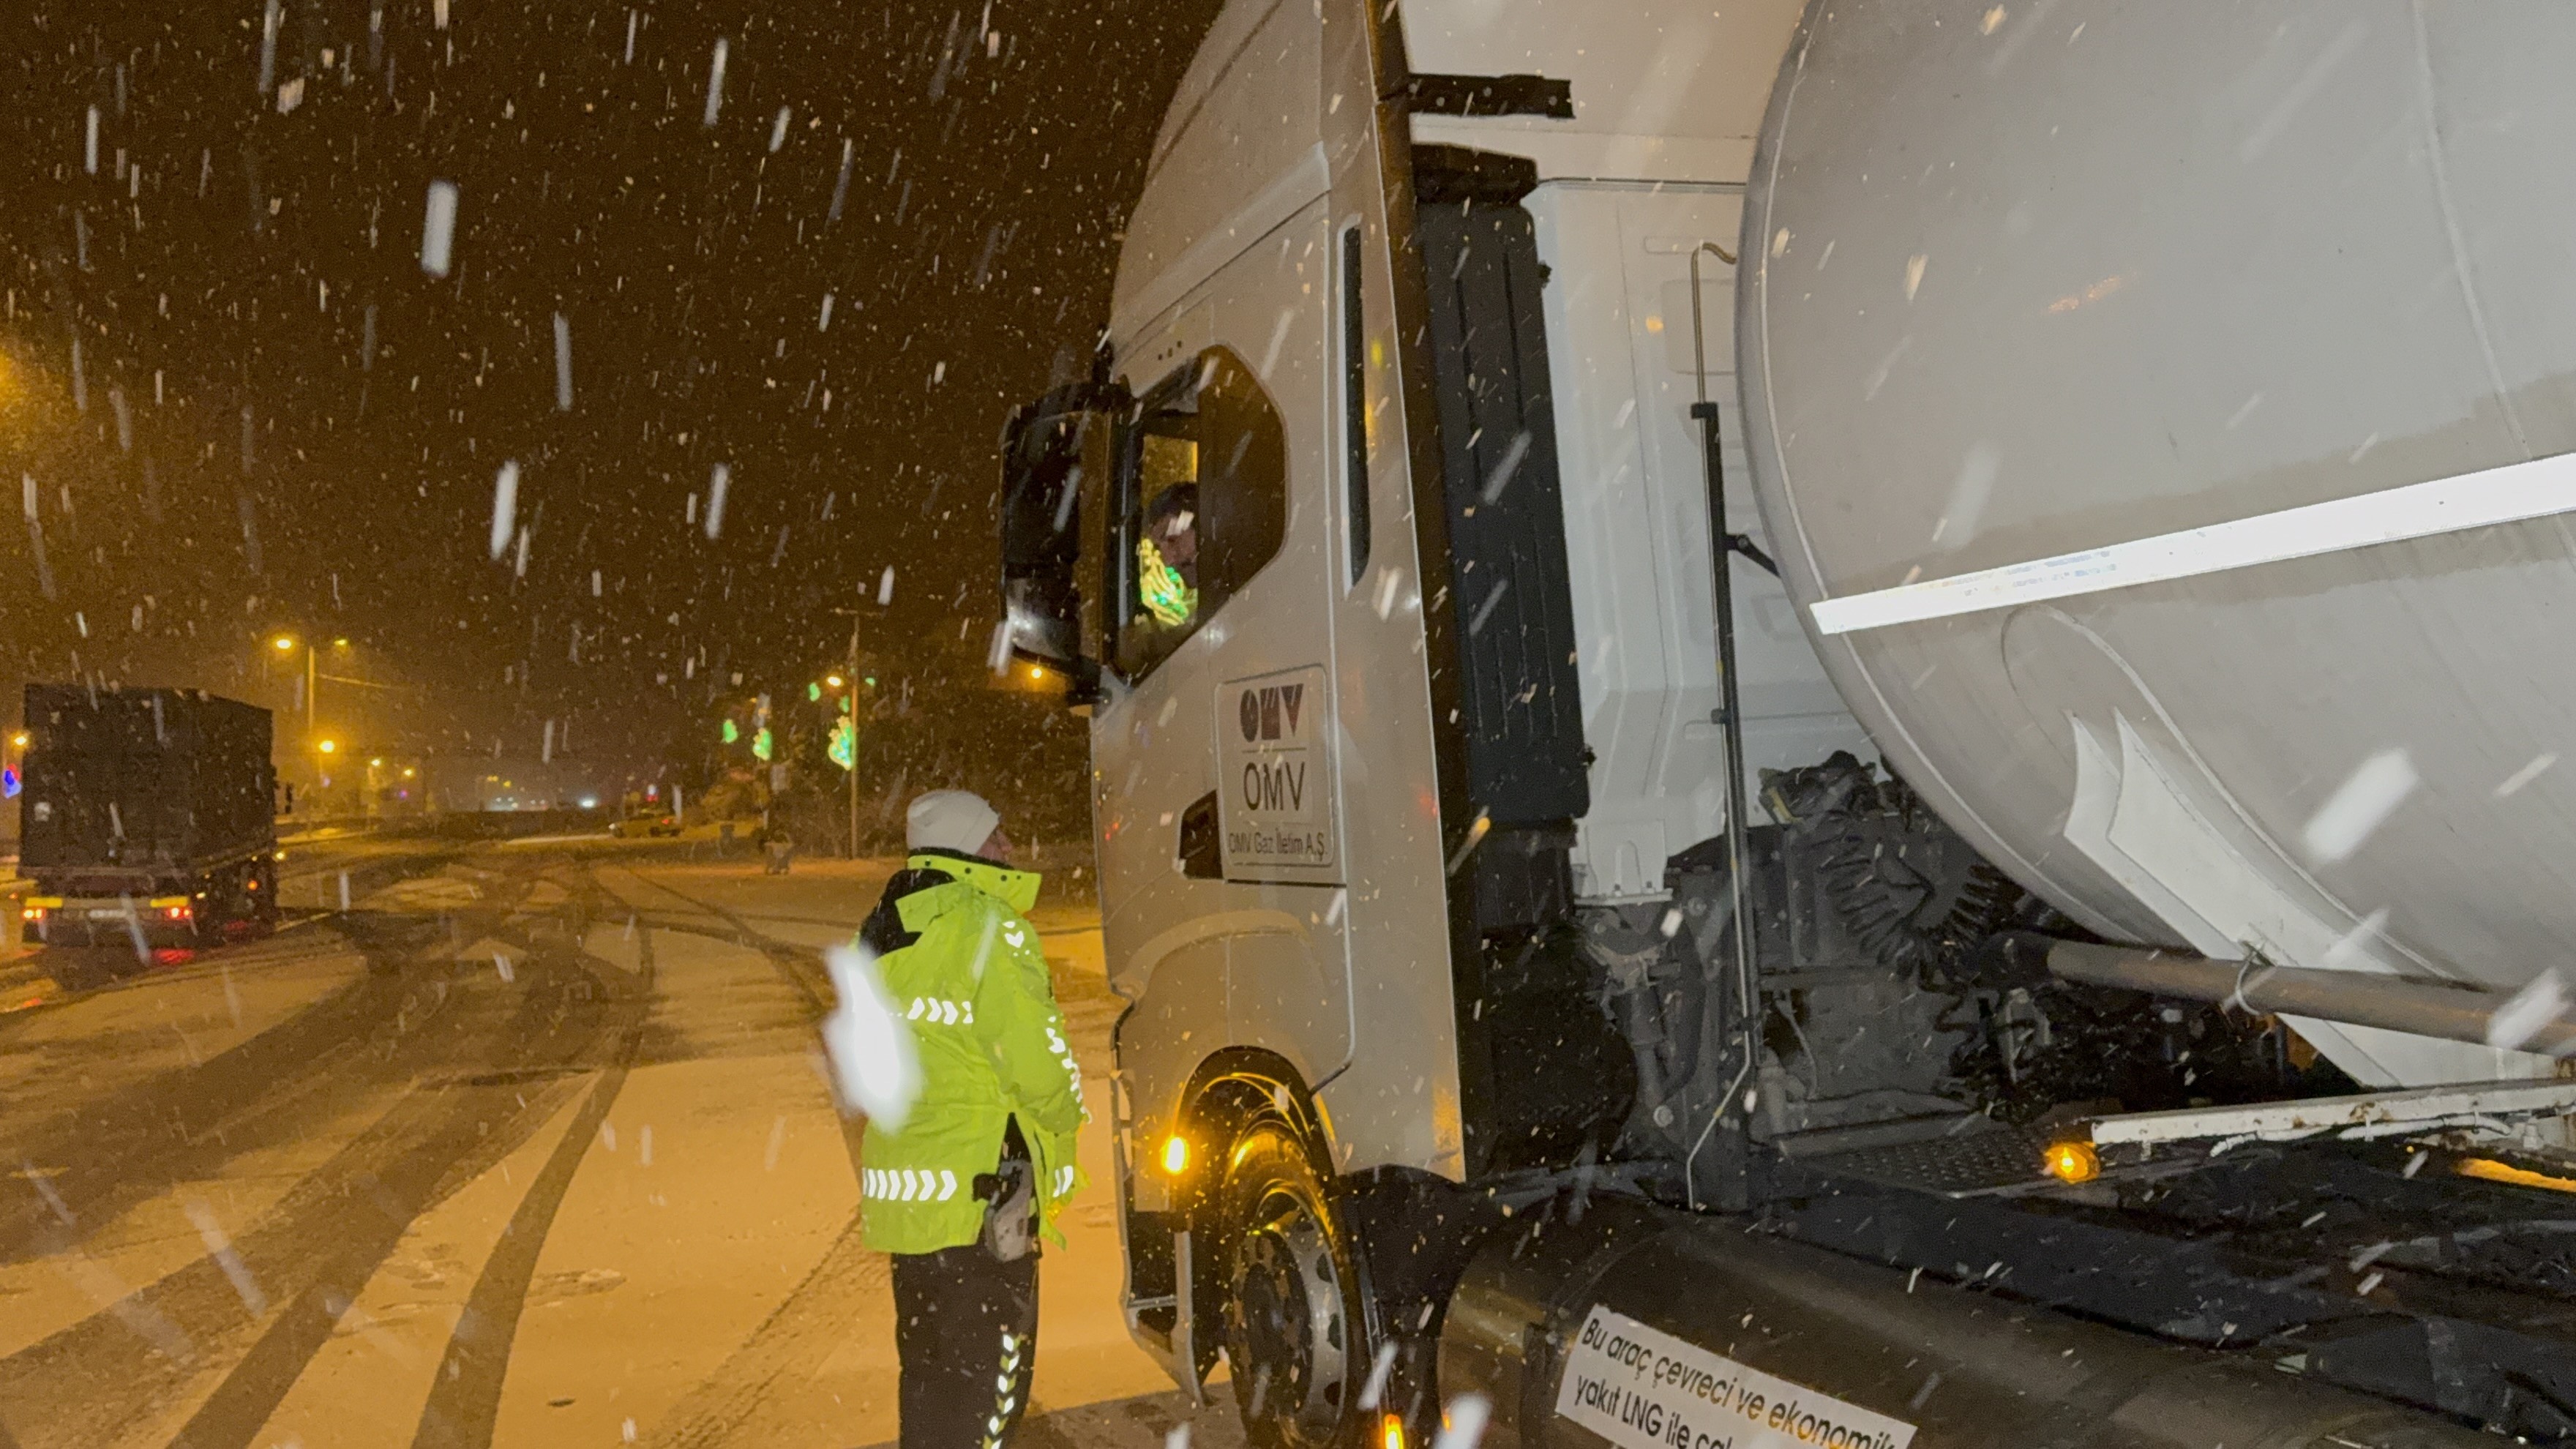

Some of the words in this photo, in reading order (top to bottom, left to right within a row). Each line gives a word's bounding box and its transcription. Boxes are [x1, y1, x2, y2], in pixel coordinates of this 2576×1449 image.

[1240, 683, 1304, 743] OMV
[1244, 762, 1305, 811] OMV
[1229, 832, 1251, 853] OMV
[1254, 831, 1273, 853] Gaz
[1581, 1318, 1608, 1352] Bu
[1607, 1336, 1653, 1381] araç
[1652, 1356, 1738, 1408] çevreci
[1736, 1388, 1765, 1420] ve
[1574, 1375, 1622, 1417] yakıt
[1621, 1391, 1663, 1437] LNG
[1666, 1411, 1690, 1449] ile
